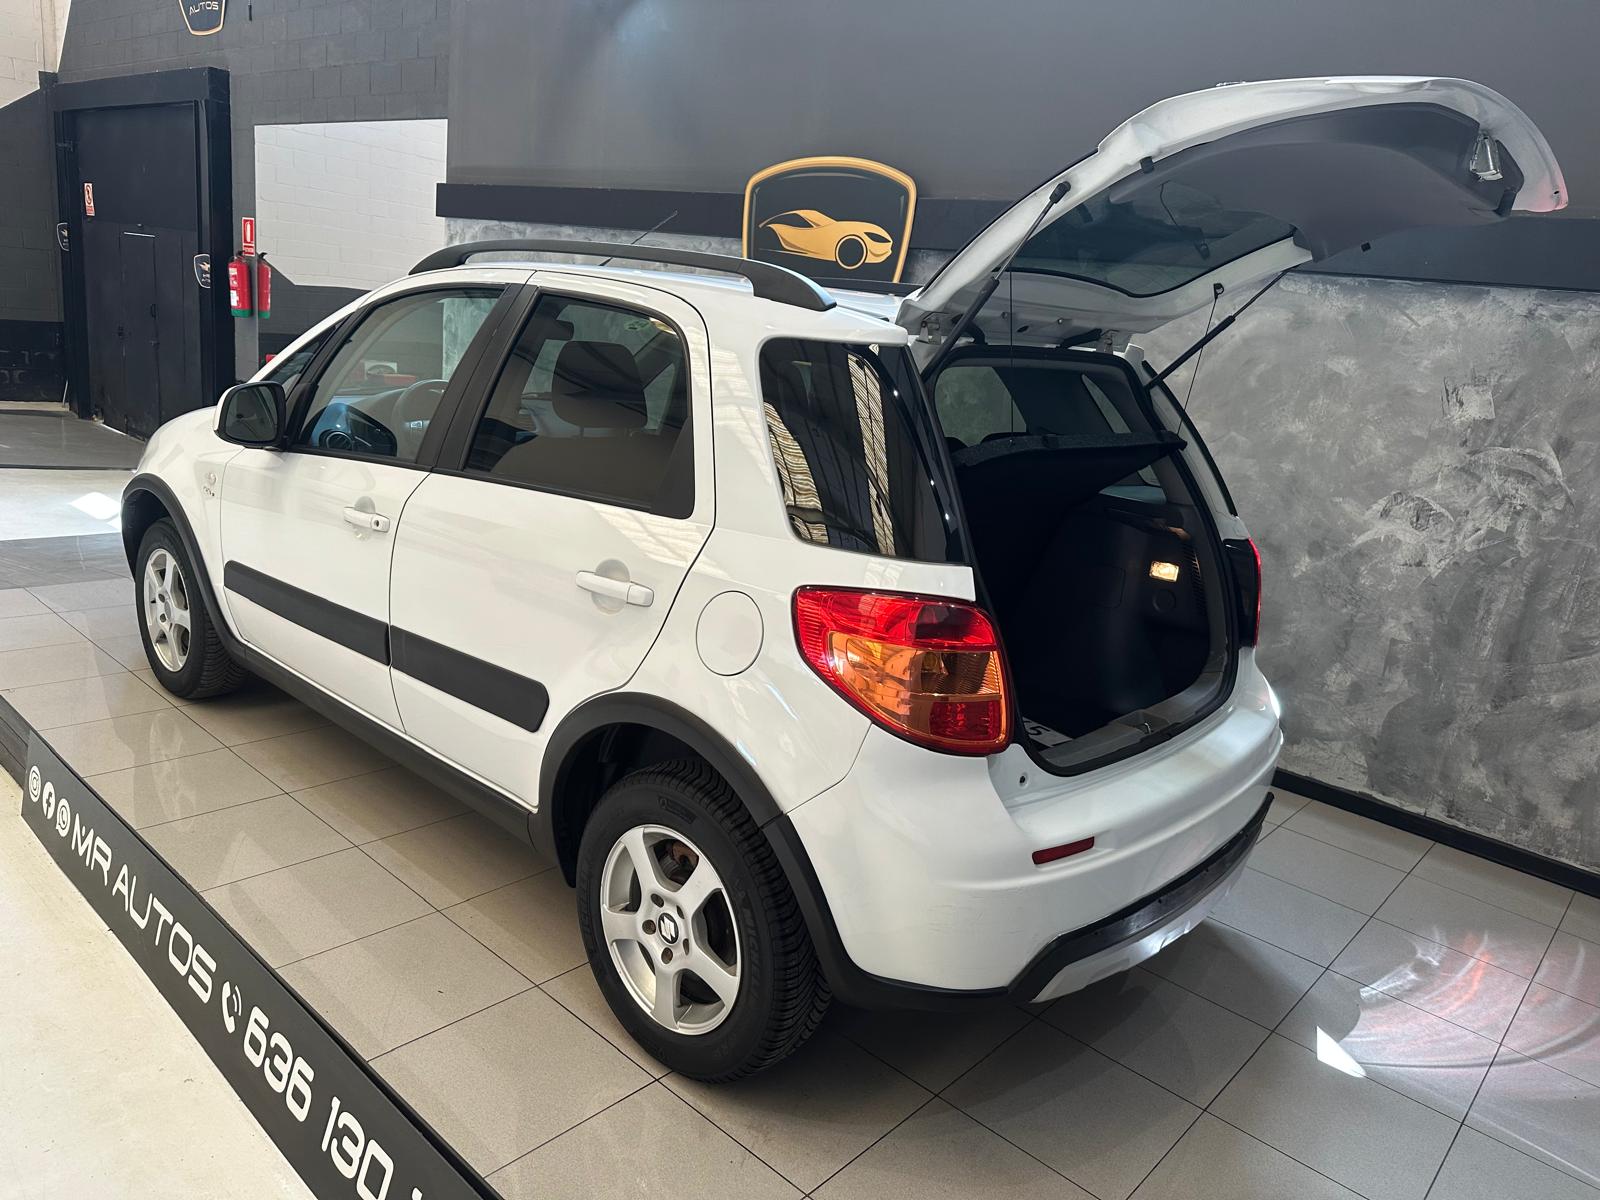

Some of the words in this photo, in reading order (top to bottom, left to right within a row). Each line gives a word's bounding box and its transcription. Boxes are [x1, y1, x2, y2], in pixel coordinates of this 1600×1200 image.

[189, 1, 219, 16] AUTOS
[71, 812, 112, 887] MR
[112, 863, 217, 1004] AUTOS
[243, 1006, 315, 1122] 636
[321, 1096, 395, 1200] 130
